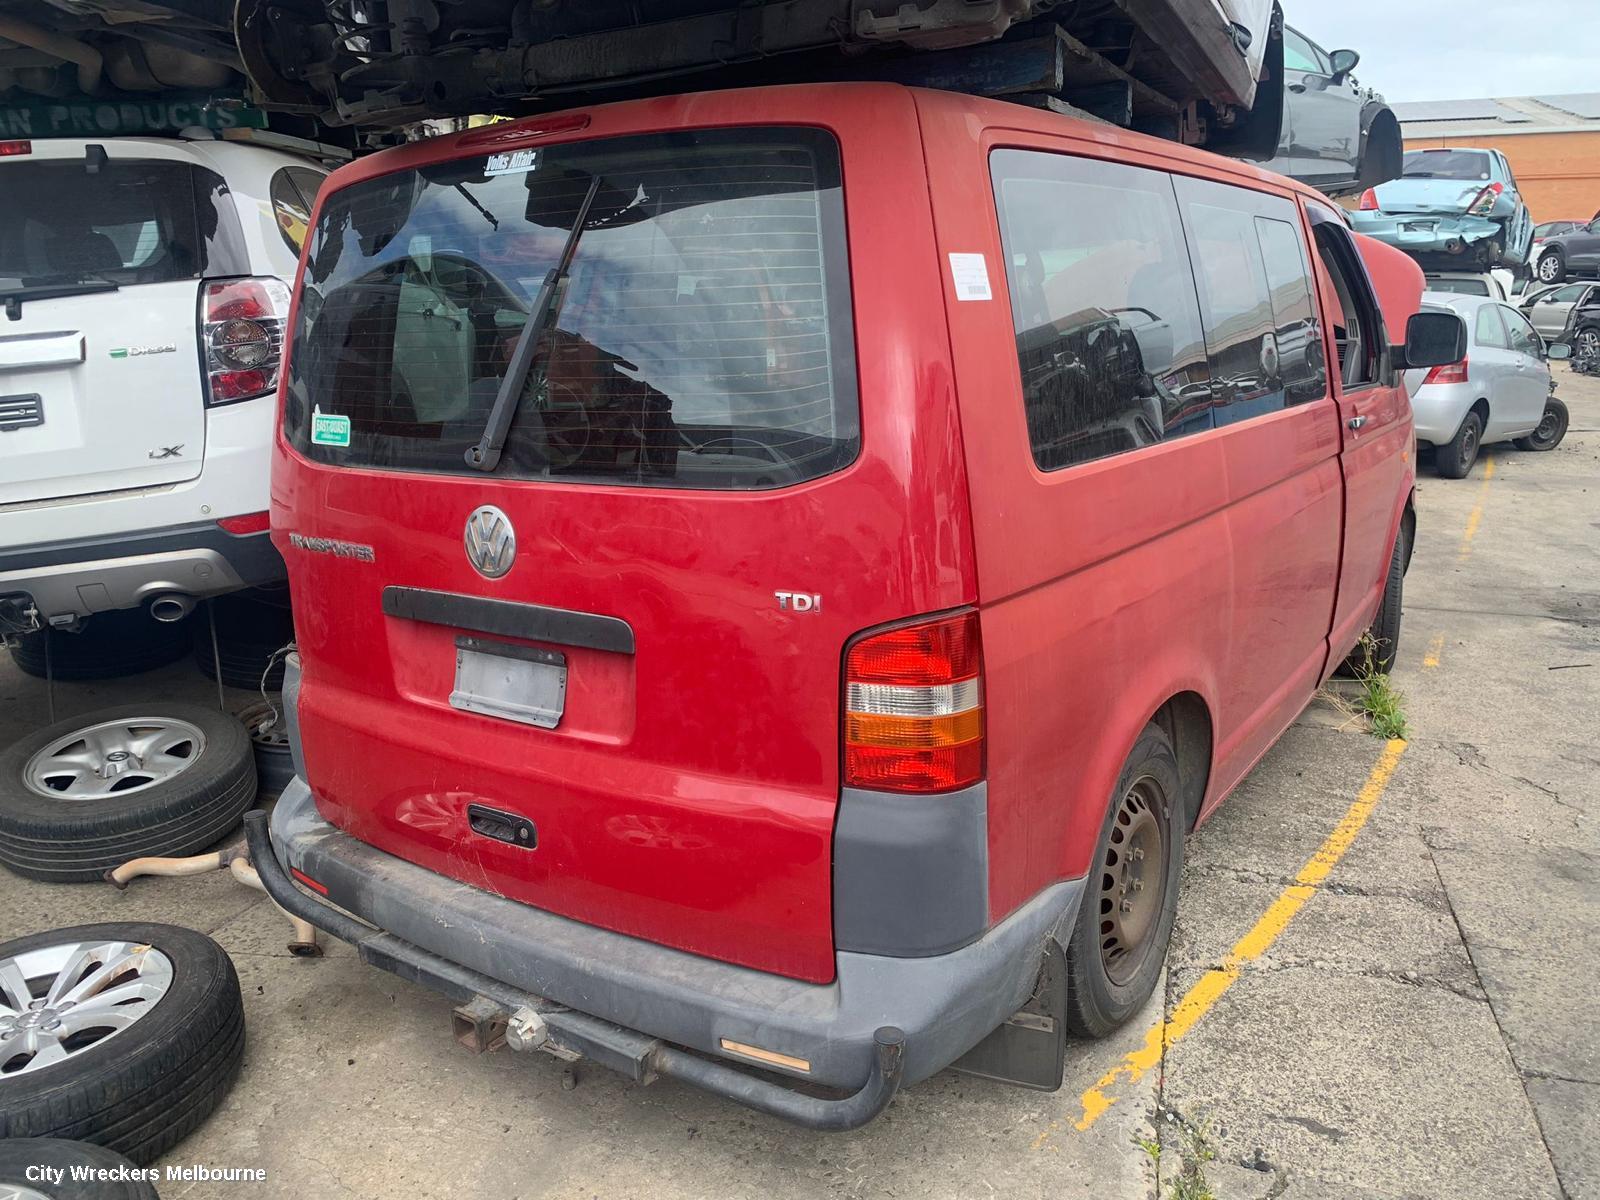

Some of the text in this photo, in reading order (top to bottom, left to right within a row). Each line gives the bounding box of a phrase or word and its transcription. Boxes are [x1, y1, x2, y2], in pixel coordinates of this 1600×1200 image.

[51, 103, 237, 130] PRODUCTS
[509, 151, 536, 167] Affair
[129, 343, 177, 357] Diesel
[148, 443, 185, 460] LX
[288, 531, 376, 563] TRANSPORTER
[774, 591, 821, 613] TDI
